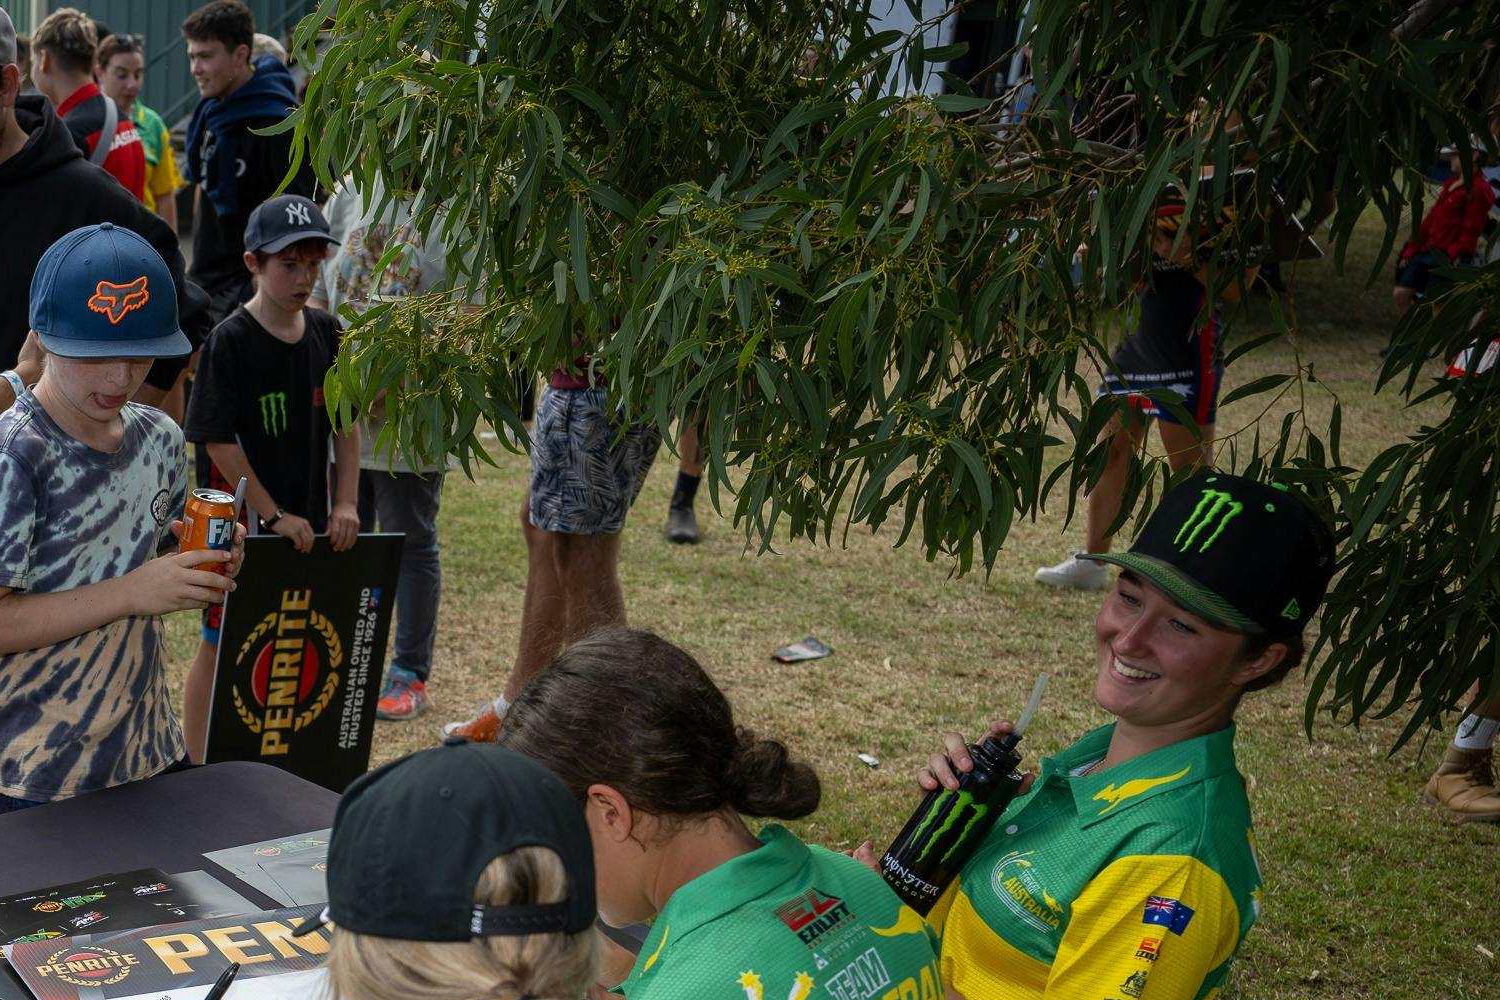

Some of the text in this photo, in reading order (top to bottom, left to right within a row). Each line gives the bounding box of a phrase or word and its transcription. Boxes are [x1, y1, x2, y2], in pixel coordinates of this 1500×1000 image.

[260, 588, 312, 756] PENRITE
[338, 587, 371, 749] AUSTRALIAN OWNED AND
[348, 612, 377, 748] TRUSTED SINCE 1926
[882, 869, 925, 900] ENERGY
[884, 852, 941, 897] MONSTER
[797, 901, 850, 946] EZILIFT
[1003, 876, 1060, 930] AUSTRALIA
[35, 951, 140, 978] PENRITE
